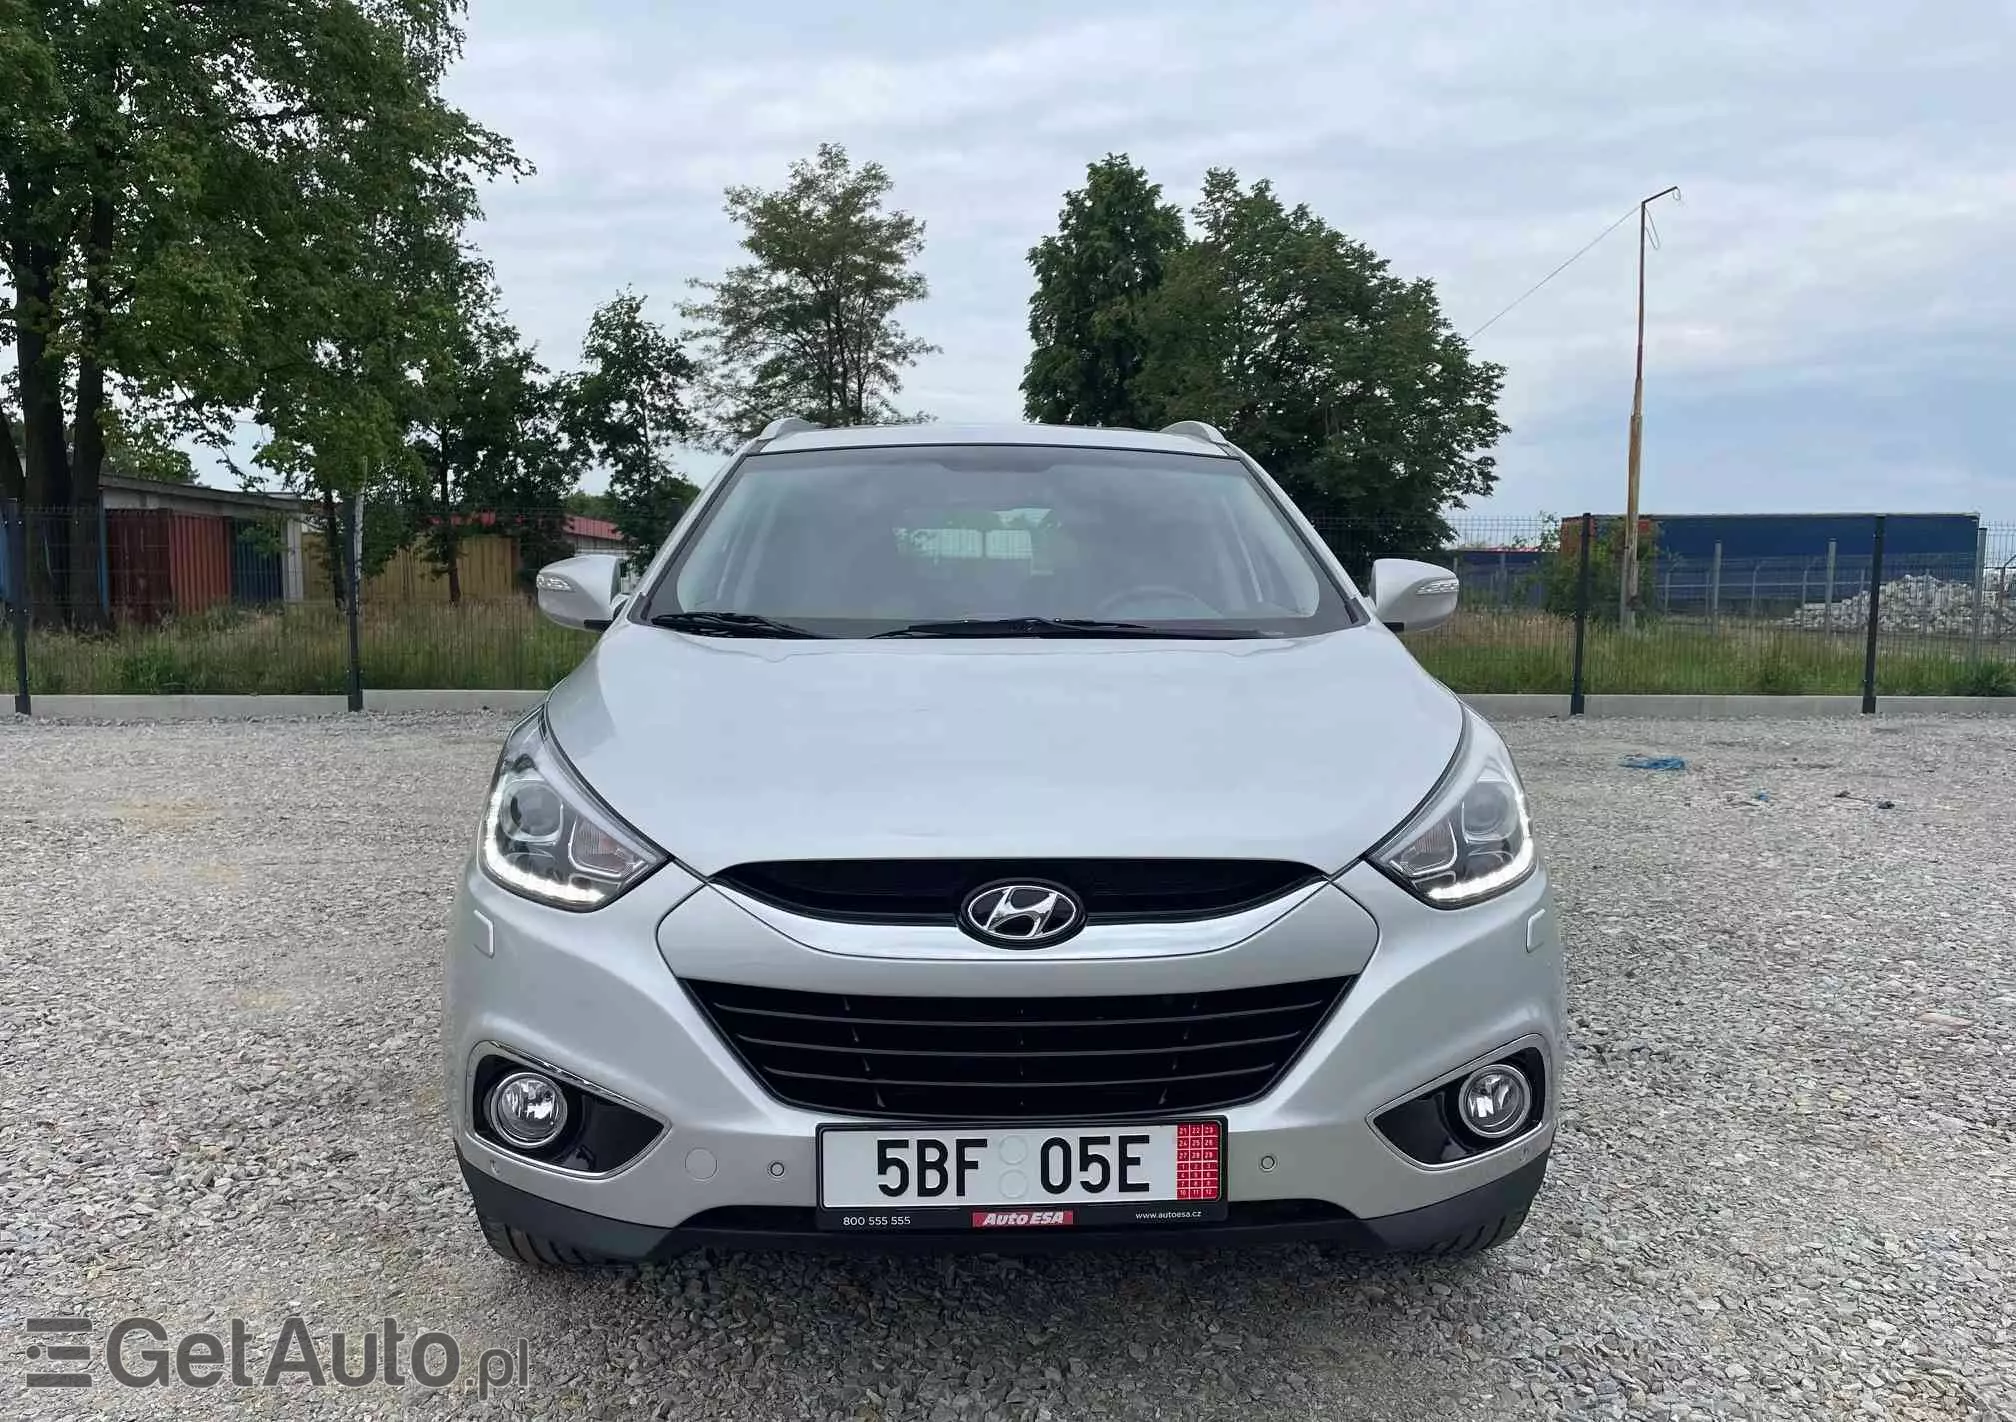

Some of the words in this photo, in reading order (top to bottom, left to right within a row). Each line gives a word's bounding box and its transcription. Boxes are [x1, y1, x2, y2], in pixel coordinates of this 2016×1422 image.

[876, 1138, 988, 1198] 5BF
[1040, 1134, 1150, 1195] 05E
[843, 1216, 865, 1226] 800
[868, 1216, 888, 1226] 555
[890, 1215, 911, 1225] 555
[982, 1212, 1027, 1226] Auto
[1029, 1211, 1064, 1225] ESA
[1135, 1211, 1202, 1220] www.autoesa.cz
